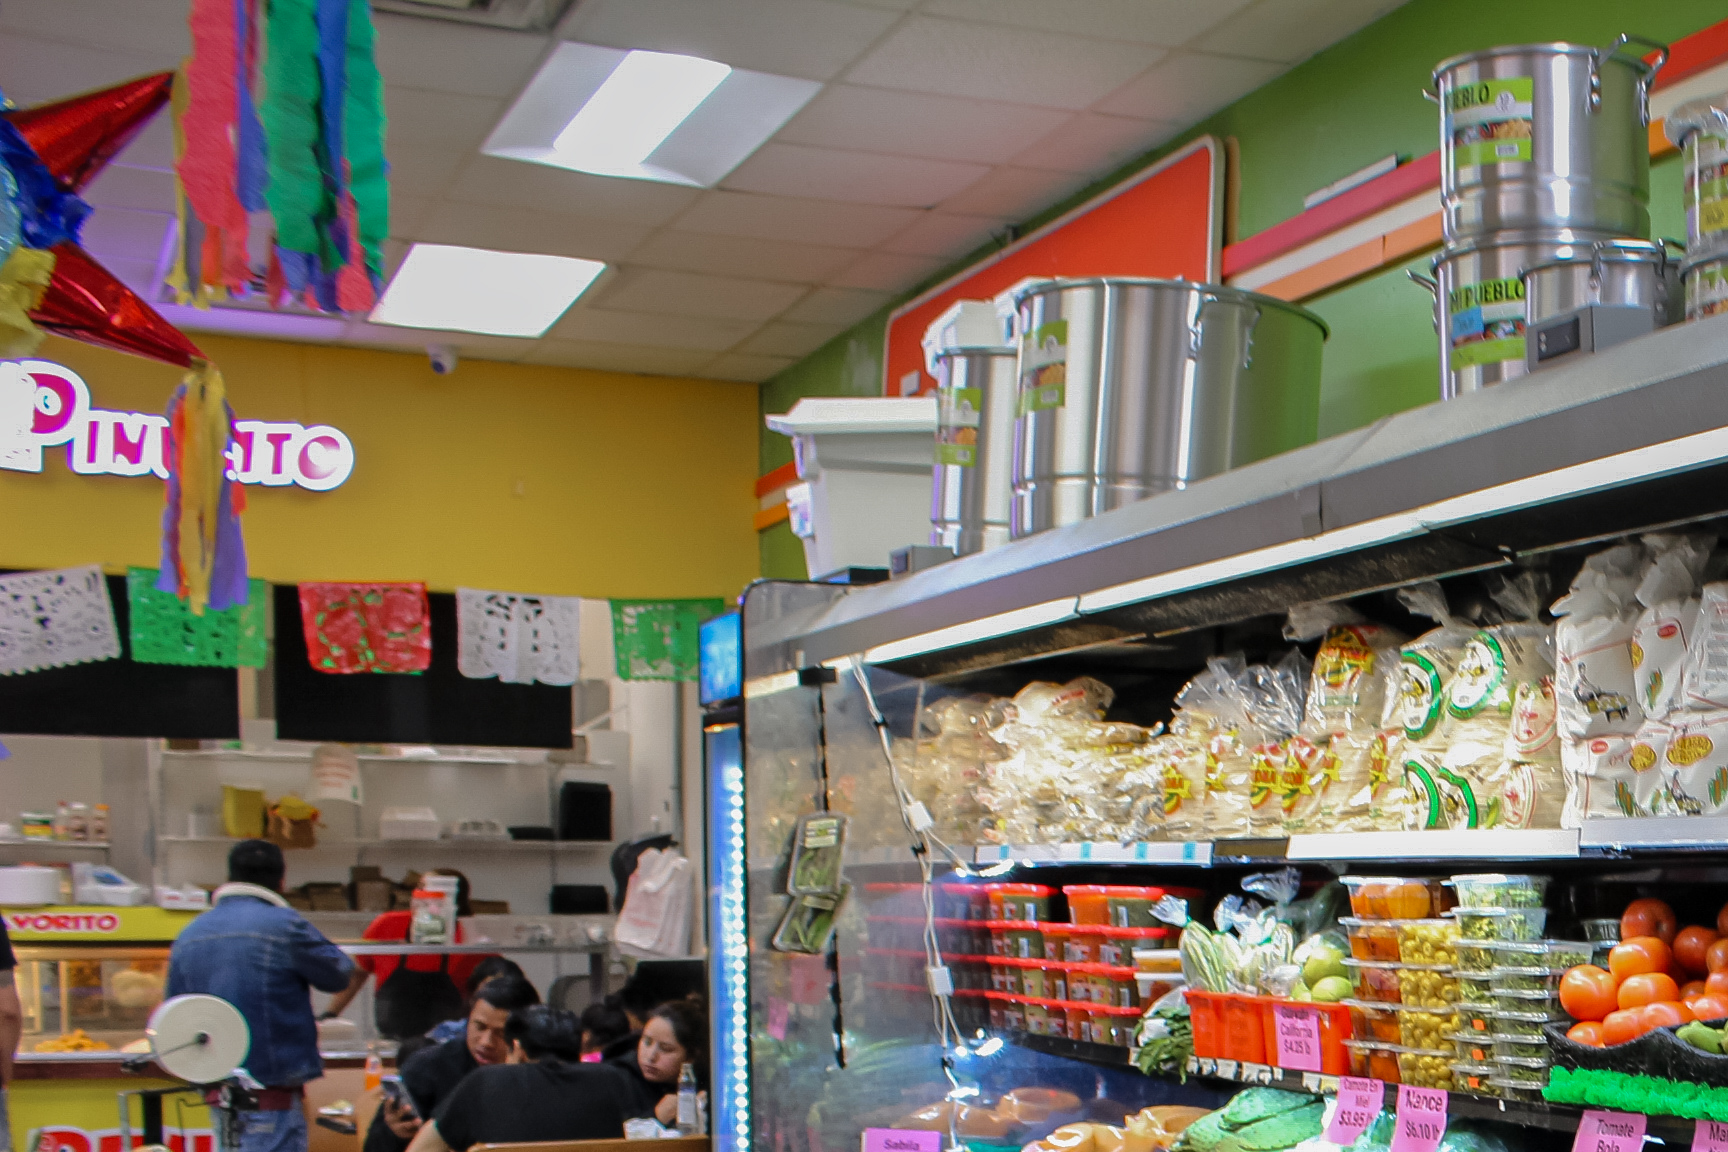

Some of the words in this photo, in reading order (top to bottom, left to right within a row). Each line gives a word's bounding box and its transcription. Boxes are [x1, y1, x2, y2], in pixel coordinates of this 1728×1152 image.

[12, 914, 117, 931] VORITO
[1405, 1089, 1443, 1112] Nance
[1596, 1119, 1635, 1139] Tomate
[883, 1138, 921, 1152] Sabila
